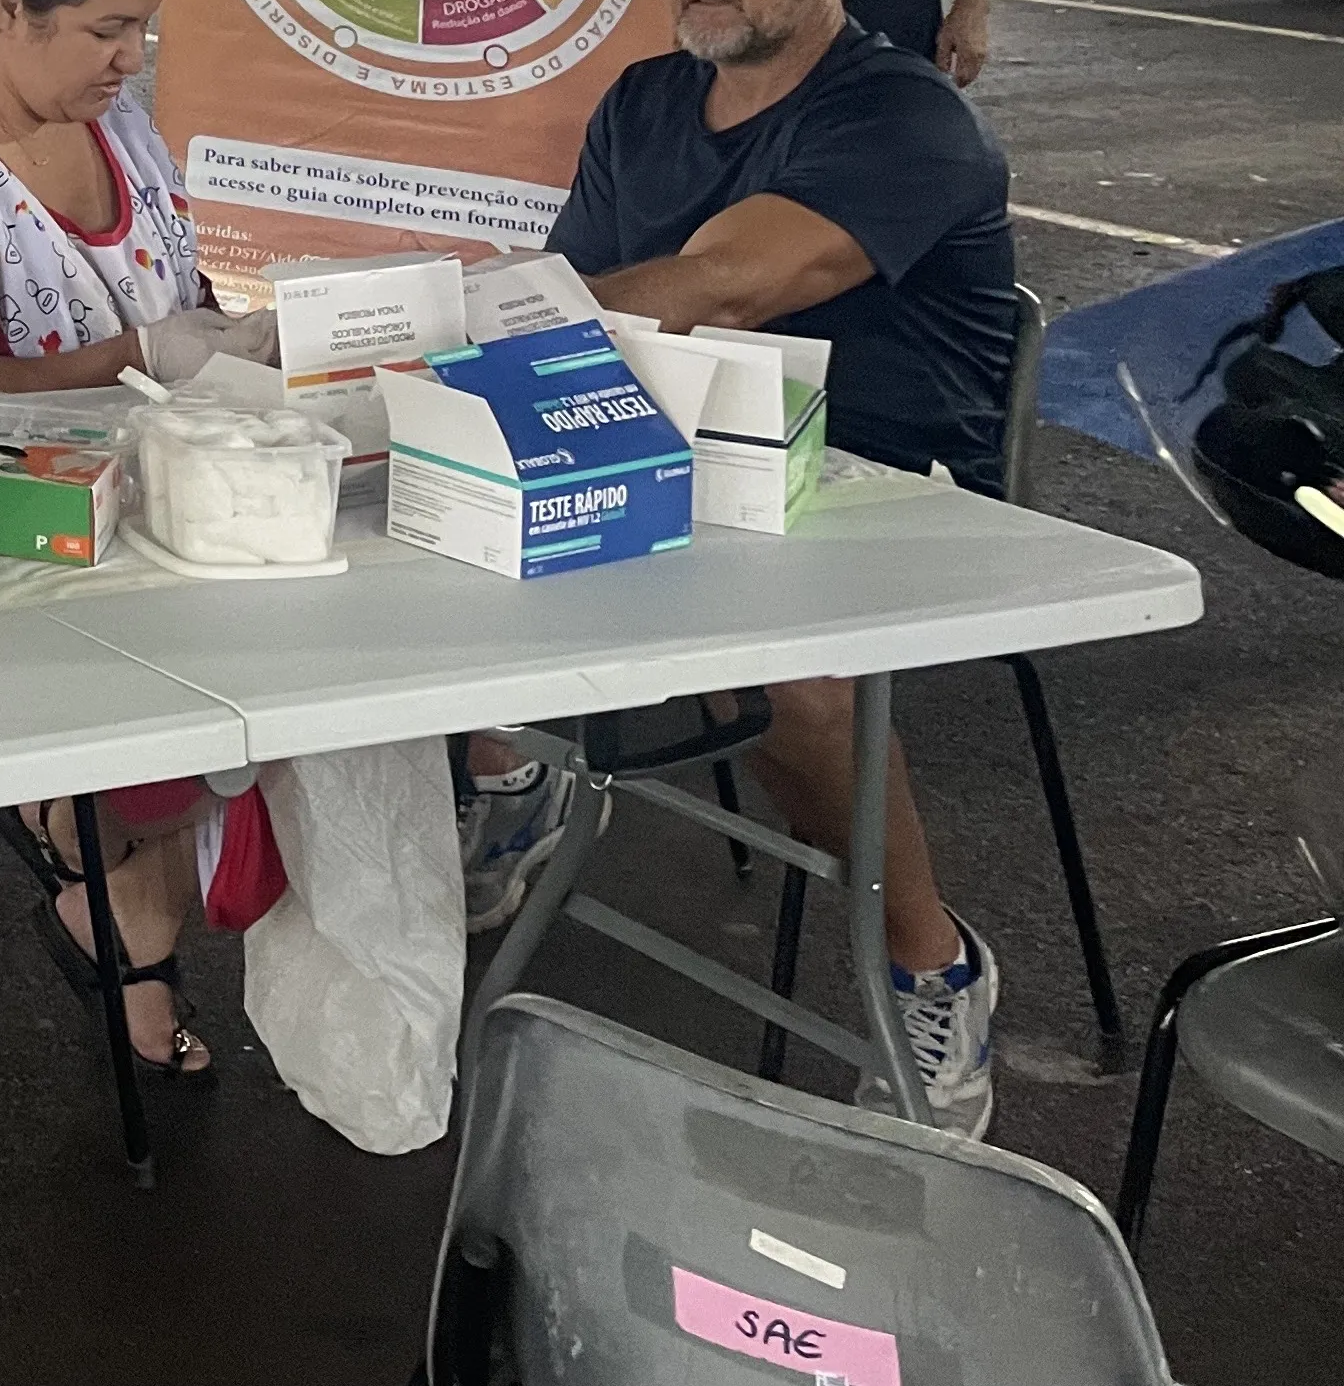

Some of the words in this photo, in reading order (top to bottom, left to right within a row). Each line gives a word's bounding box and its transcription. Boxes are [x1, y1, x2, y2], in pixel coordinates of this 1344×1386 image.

[356, 65, 370, 81] E
[531, 55, 563, 79] DO
[391, 75, 513, 96] ESTIGMA
[204, 148, 246, 169] Para
[250, 155, 300, 177] saber
[307, 164, 352, 184] mais
[355, 170, 411, 192] sobre
[415, 181, 519, 208] prevenção
[208, 174, 266, 195] acesse
[270, 184, 281, 196] o
[286, 185, 328, 205] guia
[333, 191, 425, 217] completo
[430, 206, 461, 223] em
[467, 208, 549, 236] formato
[196, 222, 253, 242] úvidas:
[542, 404, 610, 432] RÁPIDO
[602, 395, 658, 422] TESTE
[529, 495, 572, 523] TESTE
[574, 484, 627, 515] RÁPIDO
[36, 534, 48, 550] P
[735, 1309, 826, 1359] SAE
